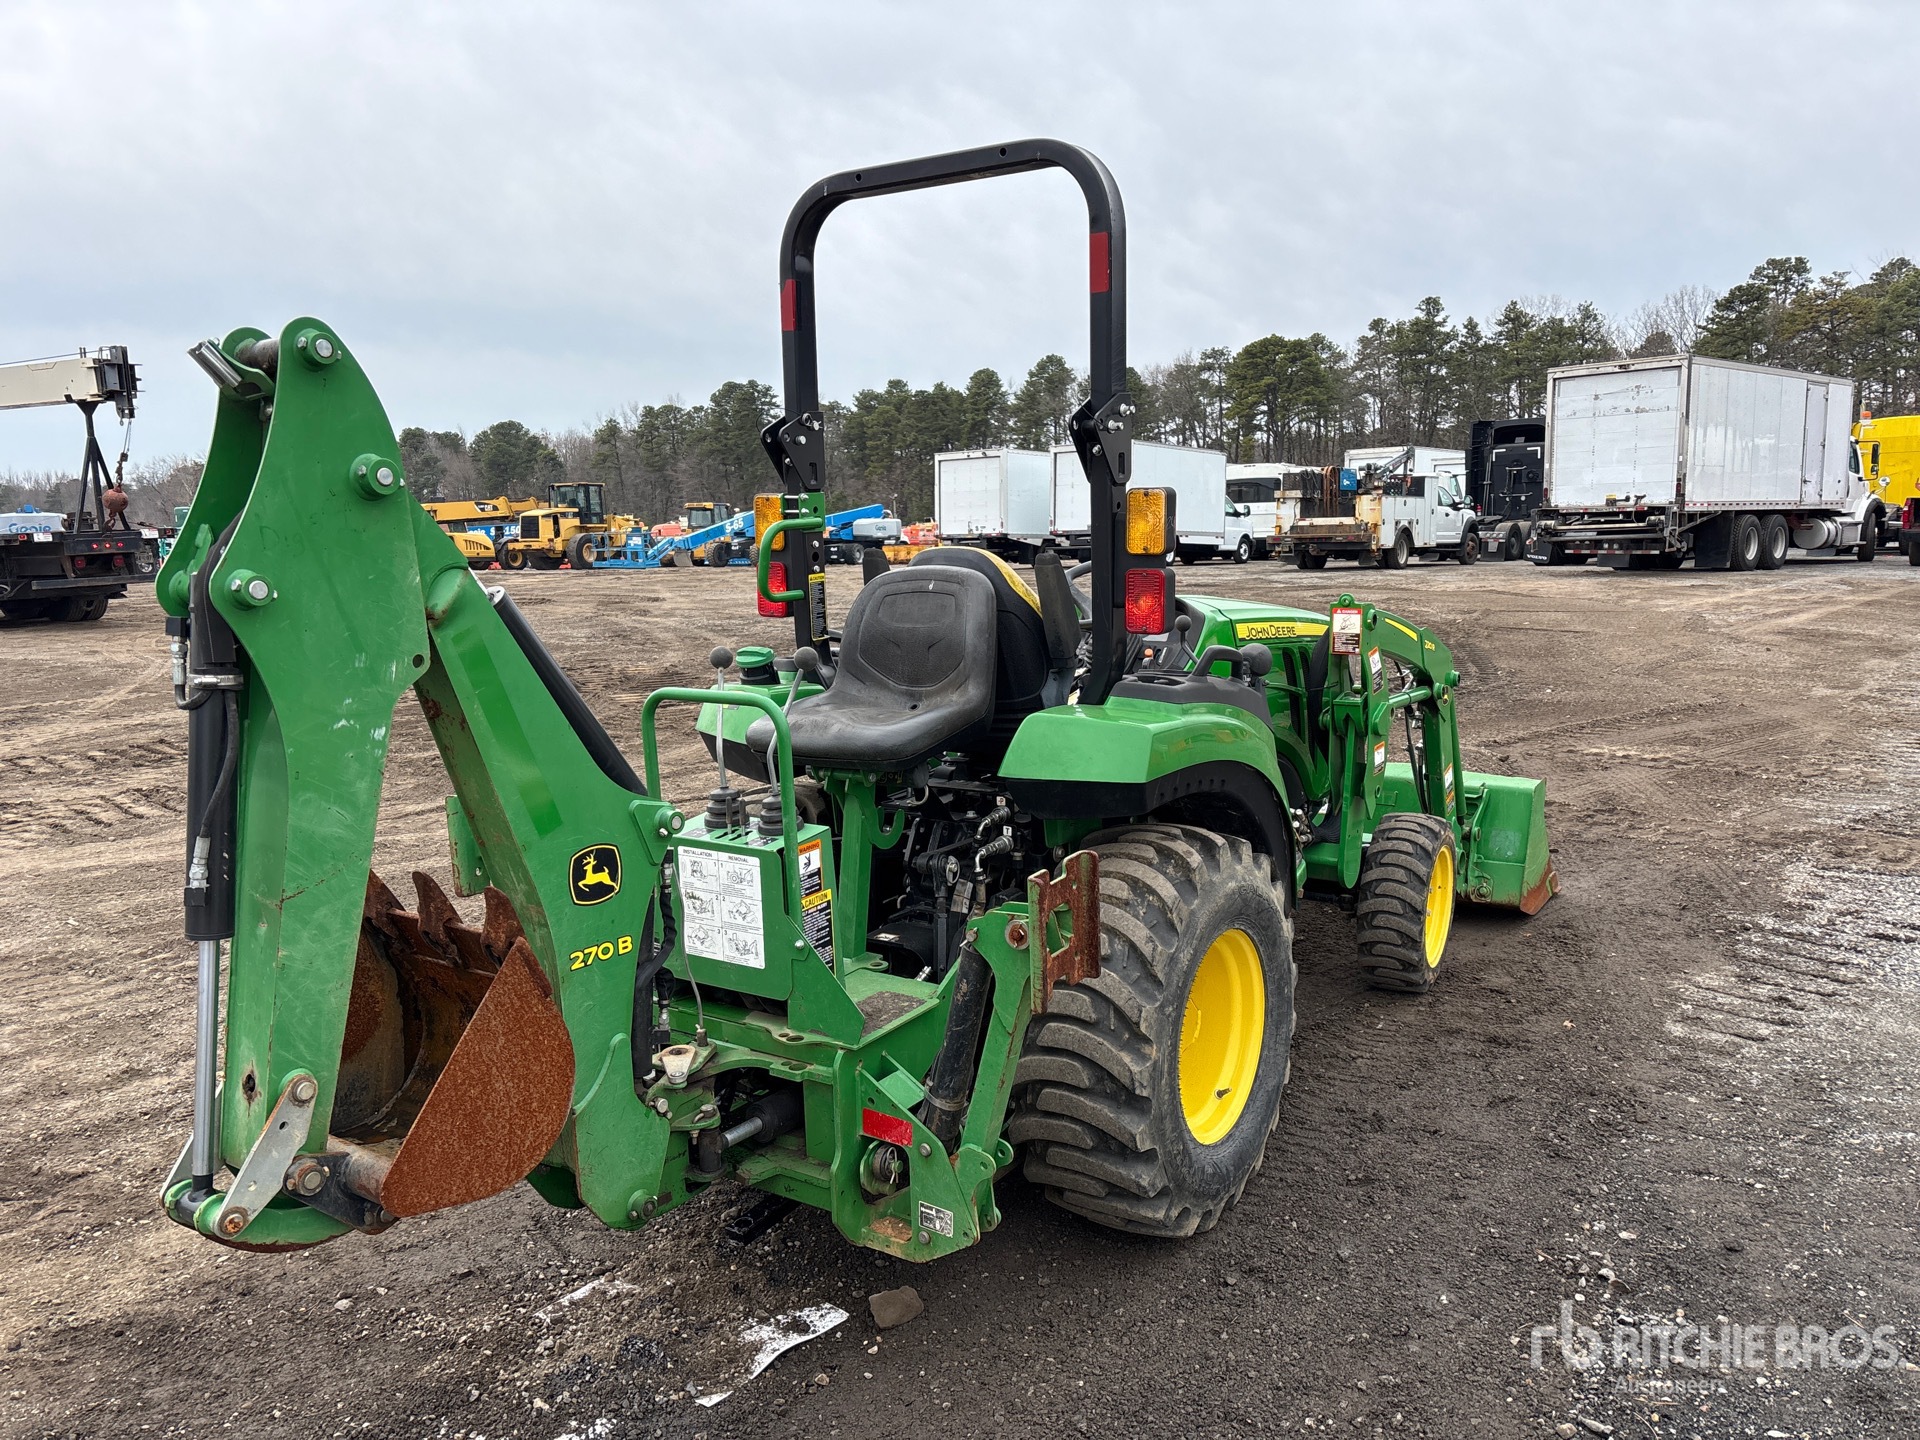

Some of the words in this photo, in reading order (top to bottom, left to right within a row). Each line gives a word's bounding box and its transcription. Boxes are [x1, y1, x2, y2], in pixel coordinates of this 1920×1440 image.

[725, 518, 744, 533] S-65
[1526, 553, 1548, 561] VOLVO
[1245, 625, 1270, 639] JOHN
[1269, 623, 1297, 637] DEERE
[1005, 827, 1011, 835] T
[682, 848, 713, 858] INSTALLATION
[798, 841, 820, 854] WARNING
[804, 891, 828, 908] CAUTION
[569, 941, 615, 972] 270
[617, 934, 634, 957] B
